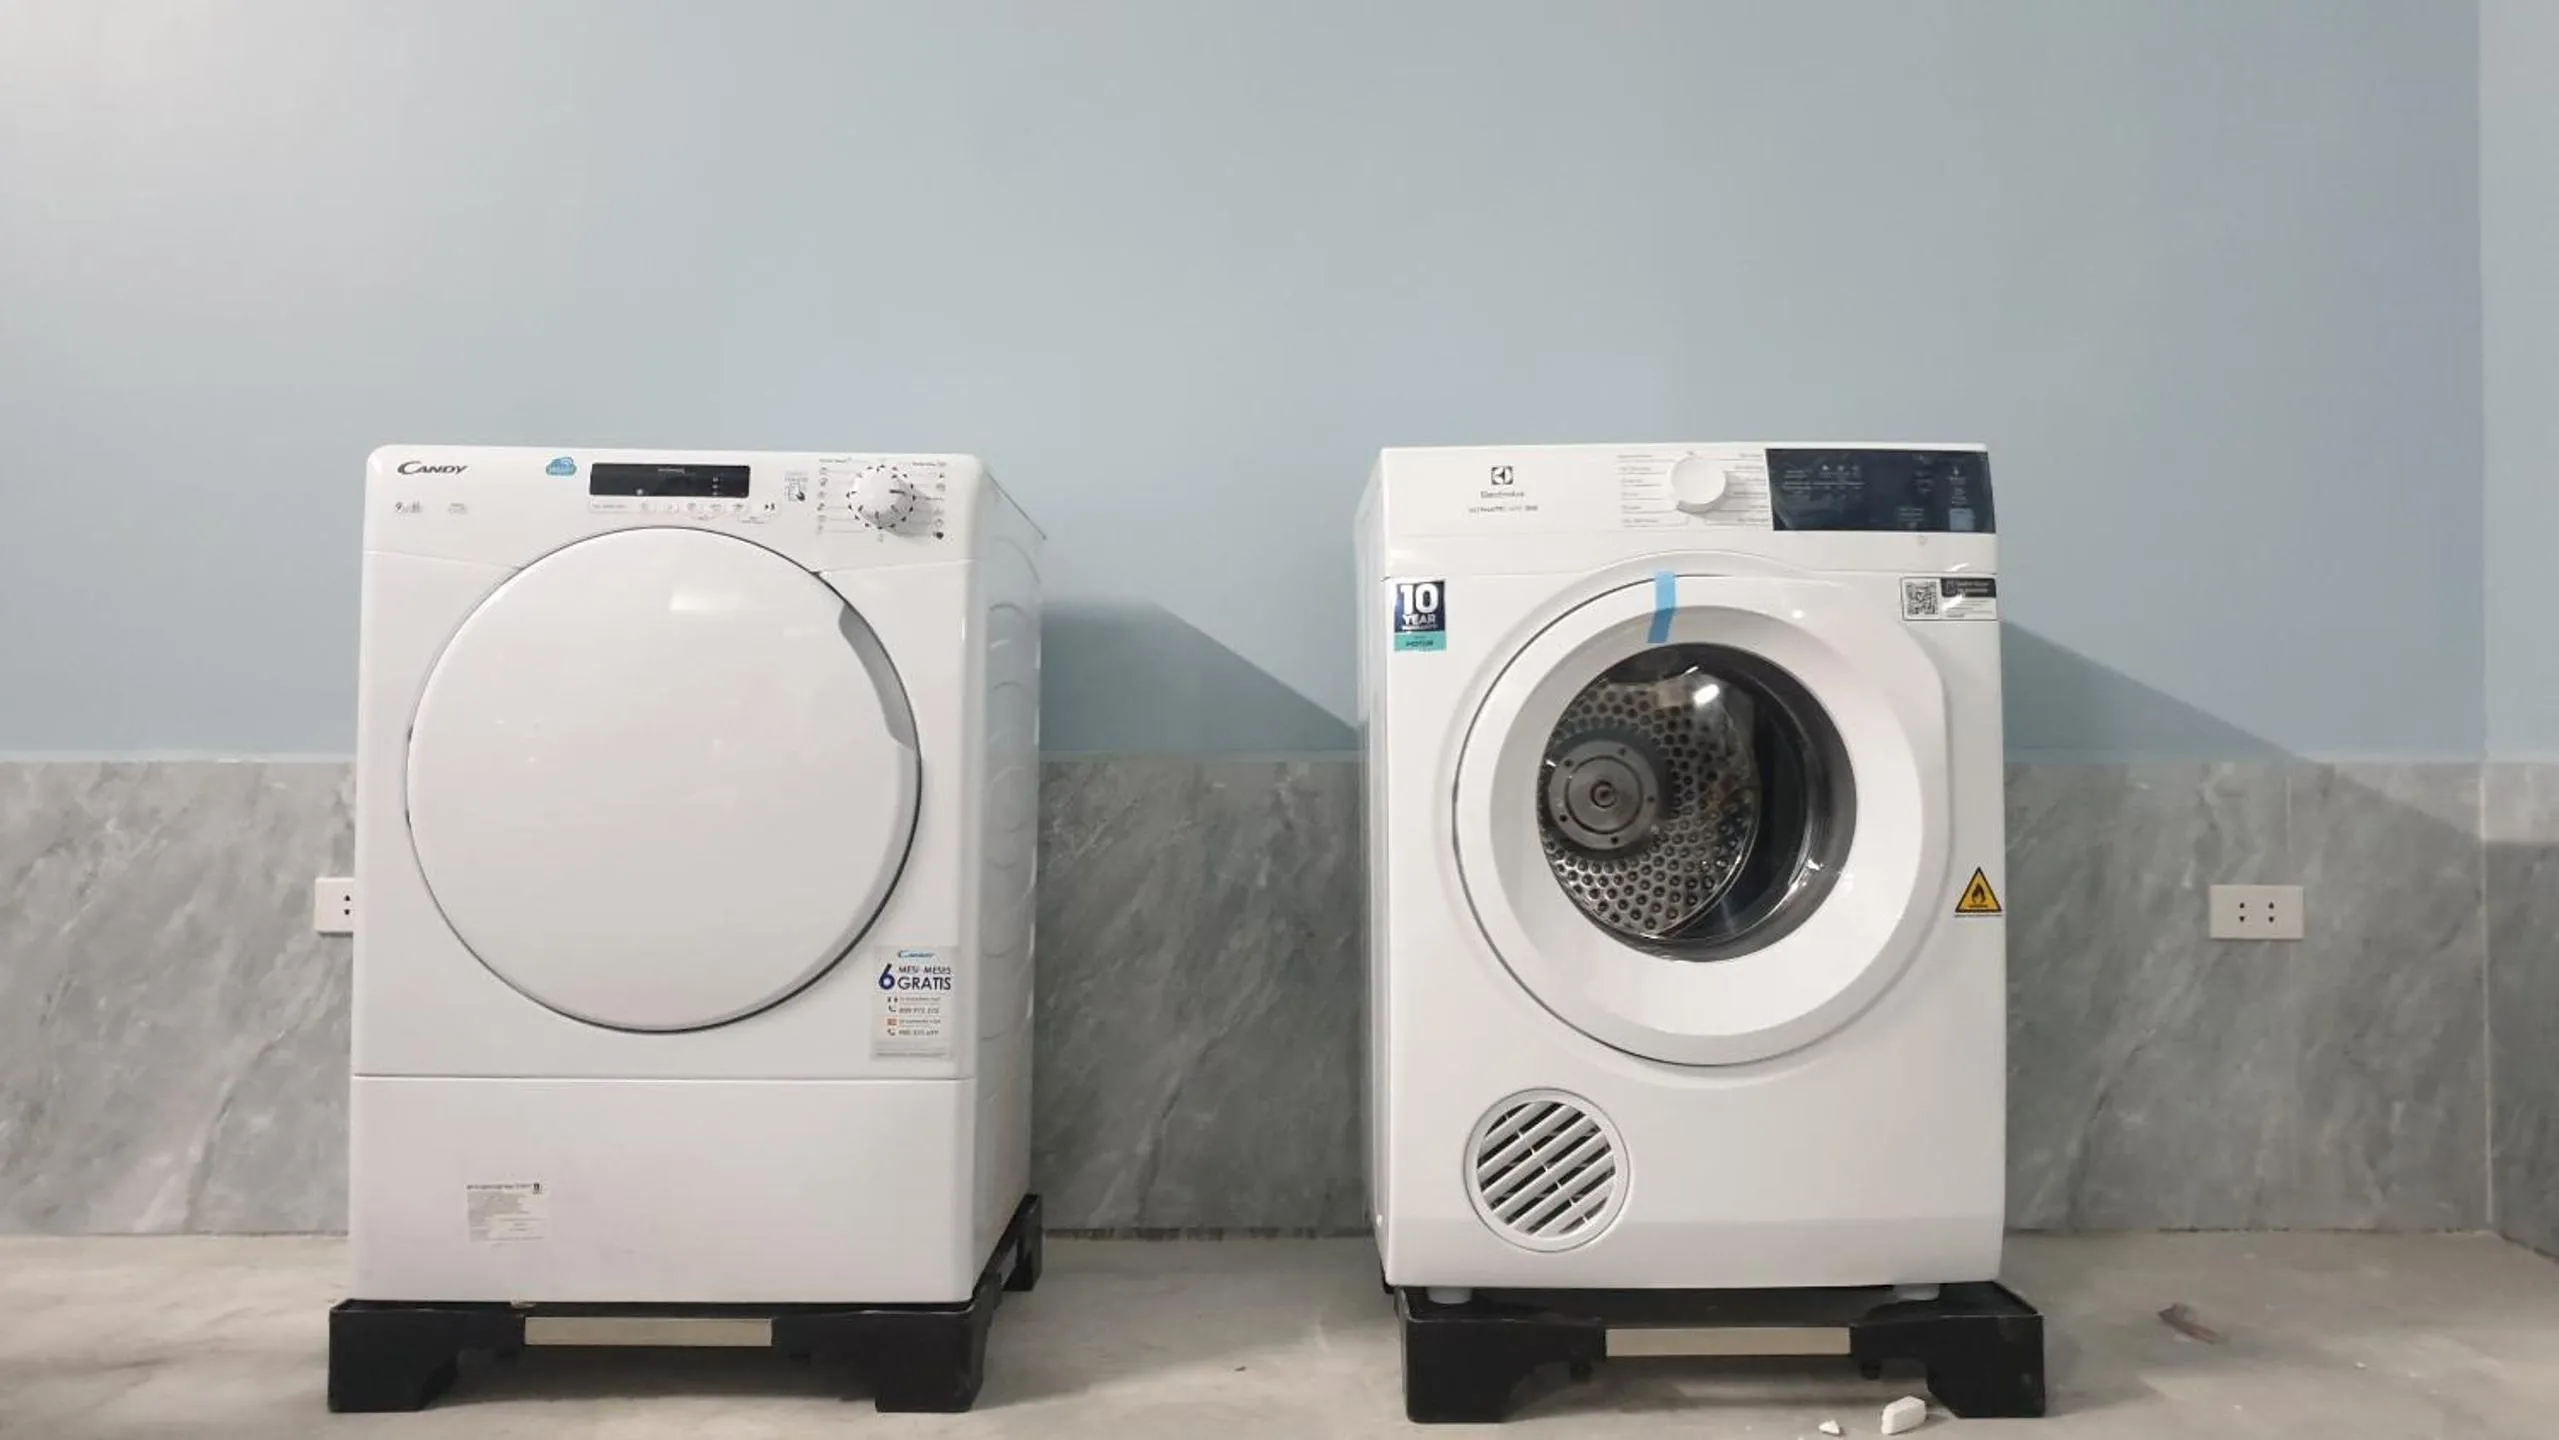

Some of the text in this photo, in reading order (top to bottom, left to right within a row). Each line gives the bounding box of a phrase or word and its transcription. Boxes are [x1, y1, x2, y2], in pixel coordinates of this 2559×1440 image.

[397, 461, 468, 475] CANDY
[1400, 583, 1439, 615] 10
[1402, 613, 1436, 625] YEAR
[879, 962, 896, 990] 6
[897, 976, 951, 990] GRATIS
